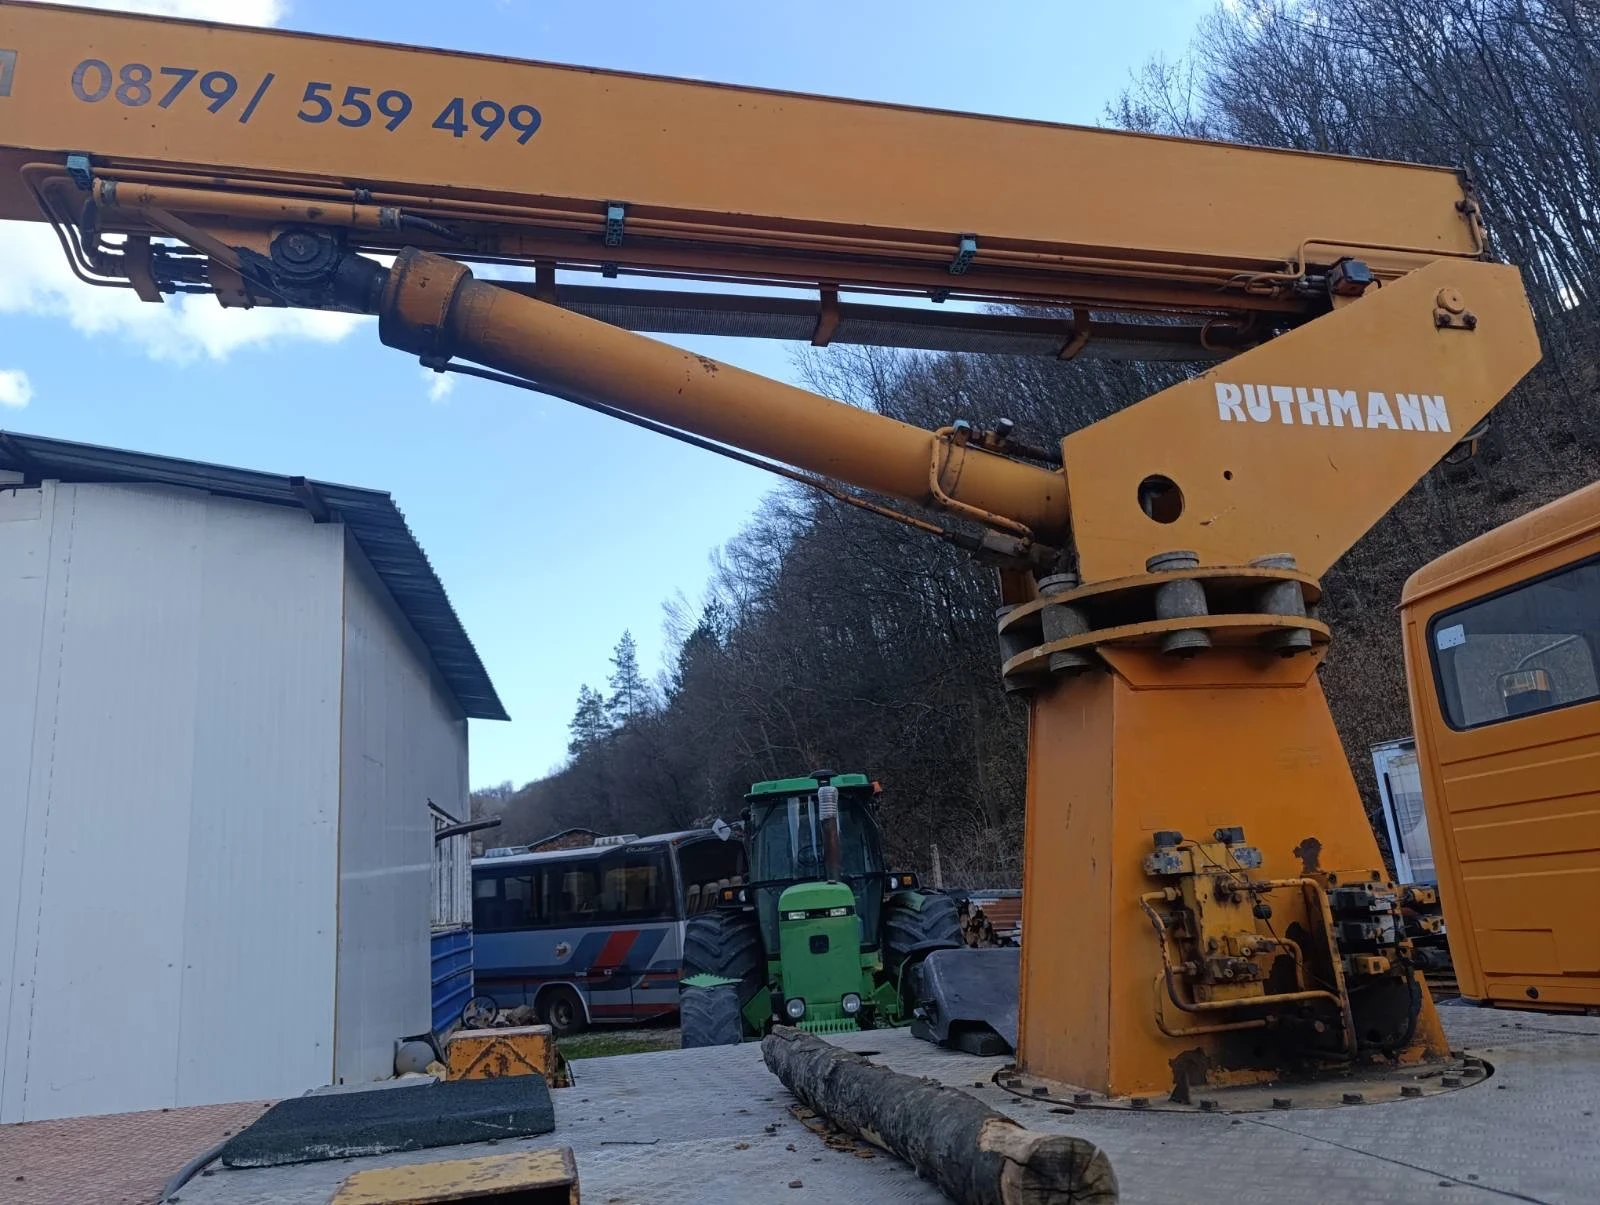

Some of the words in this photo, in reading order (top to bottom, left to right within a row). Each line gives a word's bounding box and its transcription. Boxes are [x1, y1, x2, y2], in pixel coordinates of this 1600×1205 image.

[71, 58, 275, 123] 0879/
[297, 81, 411, 131] 559
[432, 97, 541, 145] 499
[1214, 382, 1452, 433] RUTHMANN
